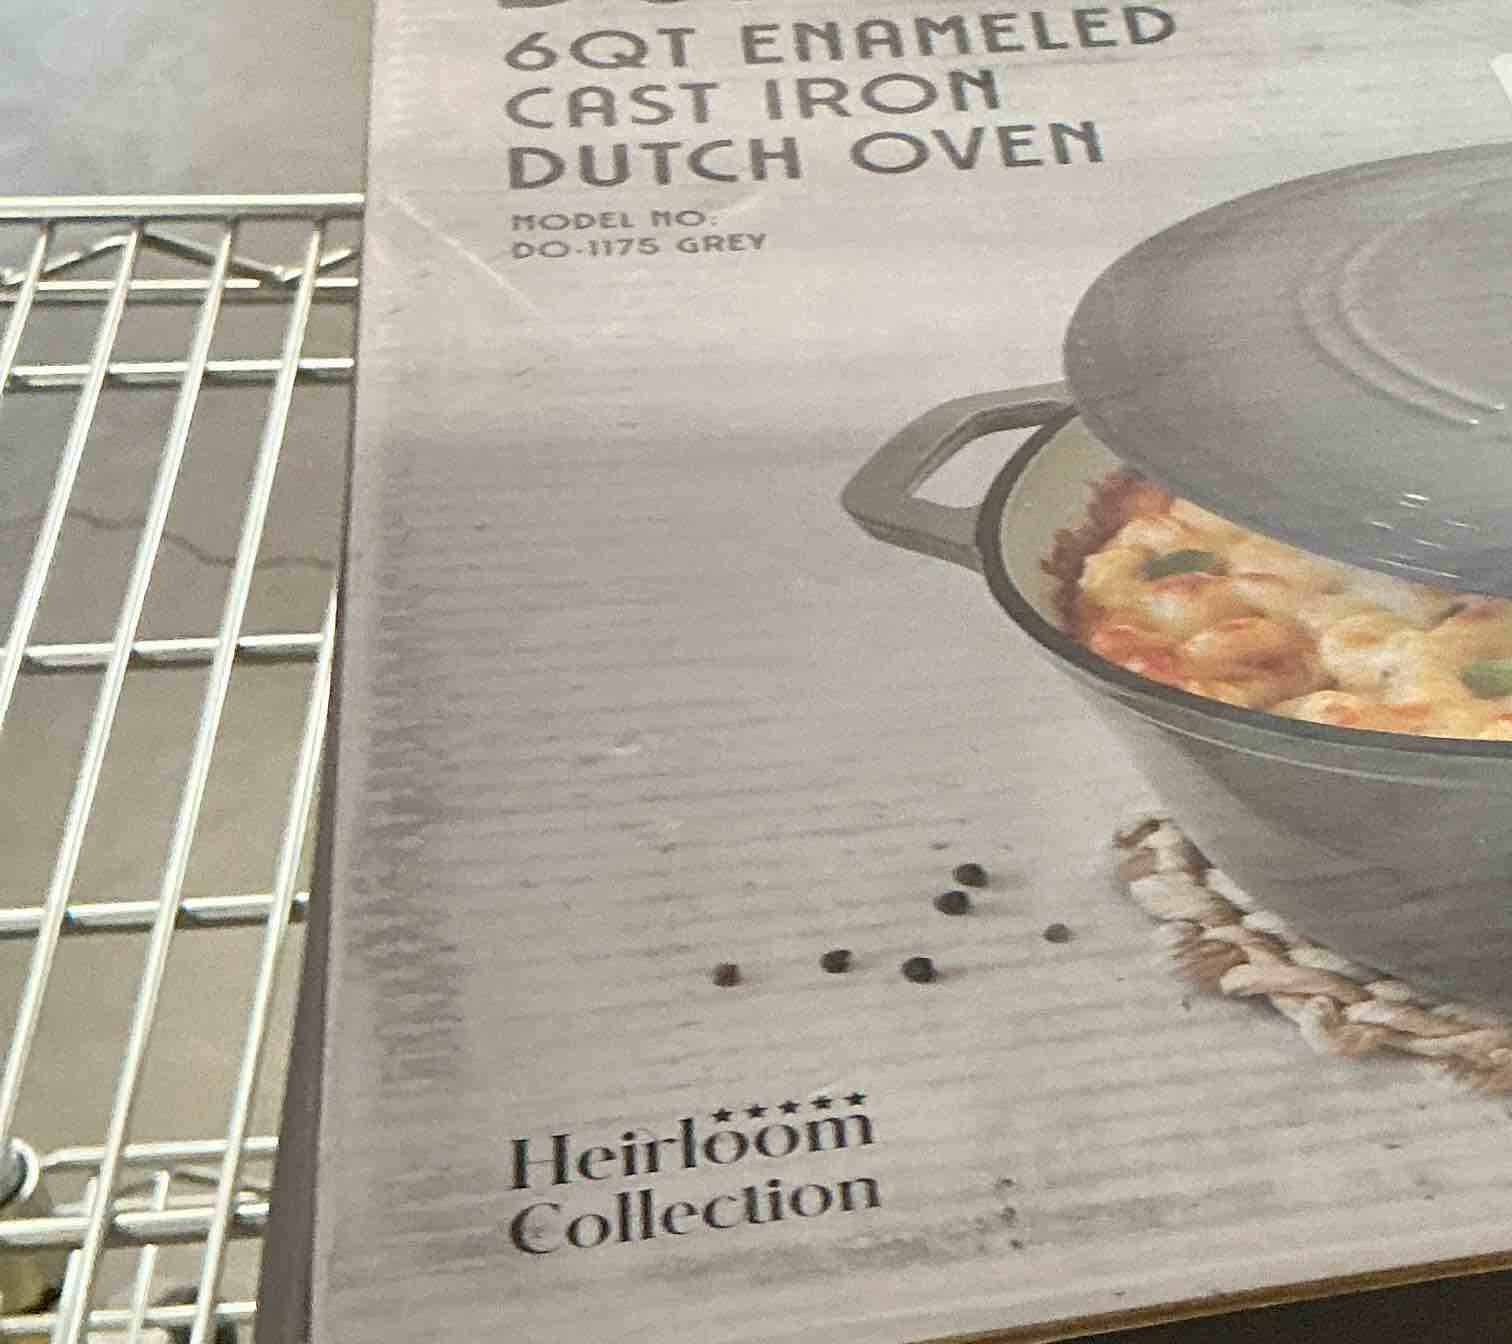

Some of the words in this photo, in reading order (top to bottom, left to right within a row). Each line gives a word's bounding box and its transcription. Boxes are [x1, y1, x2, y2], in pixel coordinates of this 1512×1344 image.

[504, 26, 696, 72] 6QT
[742, 5, 1178, 66] ENAMELED
[505, 81, 718, 129] CAST
[766, 68, 1001, 121] IRON
[509, 136, 798, 189] DUTCH
[850, 120, 1104, 174] OVEN
[511, 212, 636, 232] MODEL
[511, 238, 660, 259] DO-1175
[676, 233, 767, 254] GREY
[507, 1113, 876, 1190] Heirloom
[509, 1175, 882, 1255] Collection
